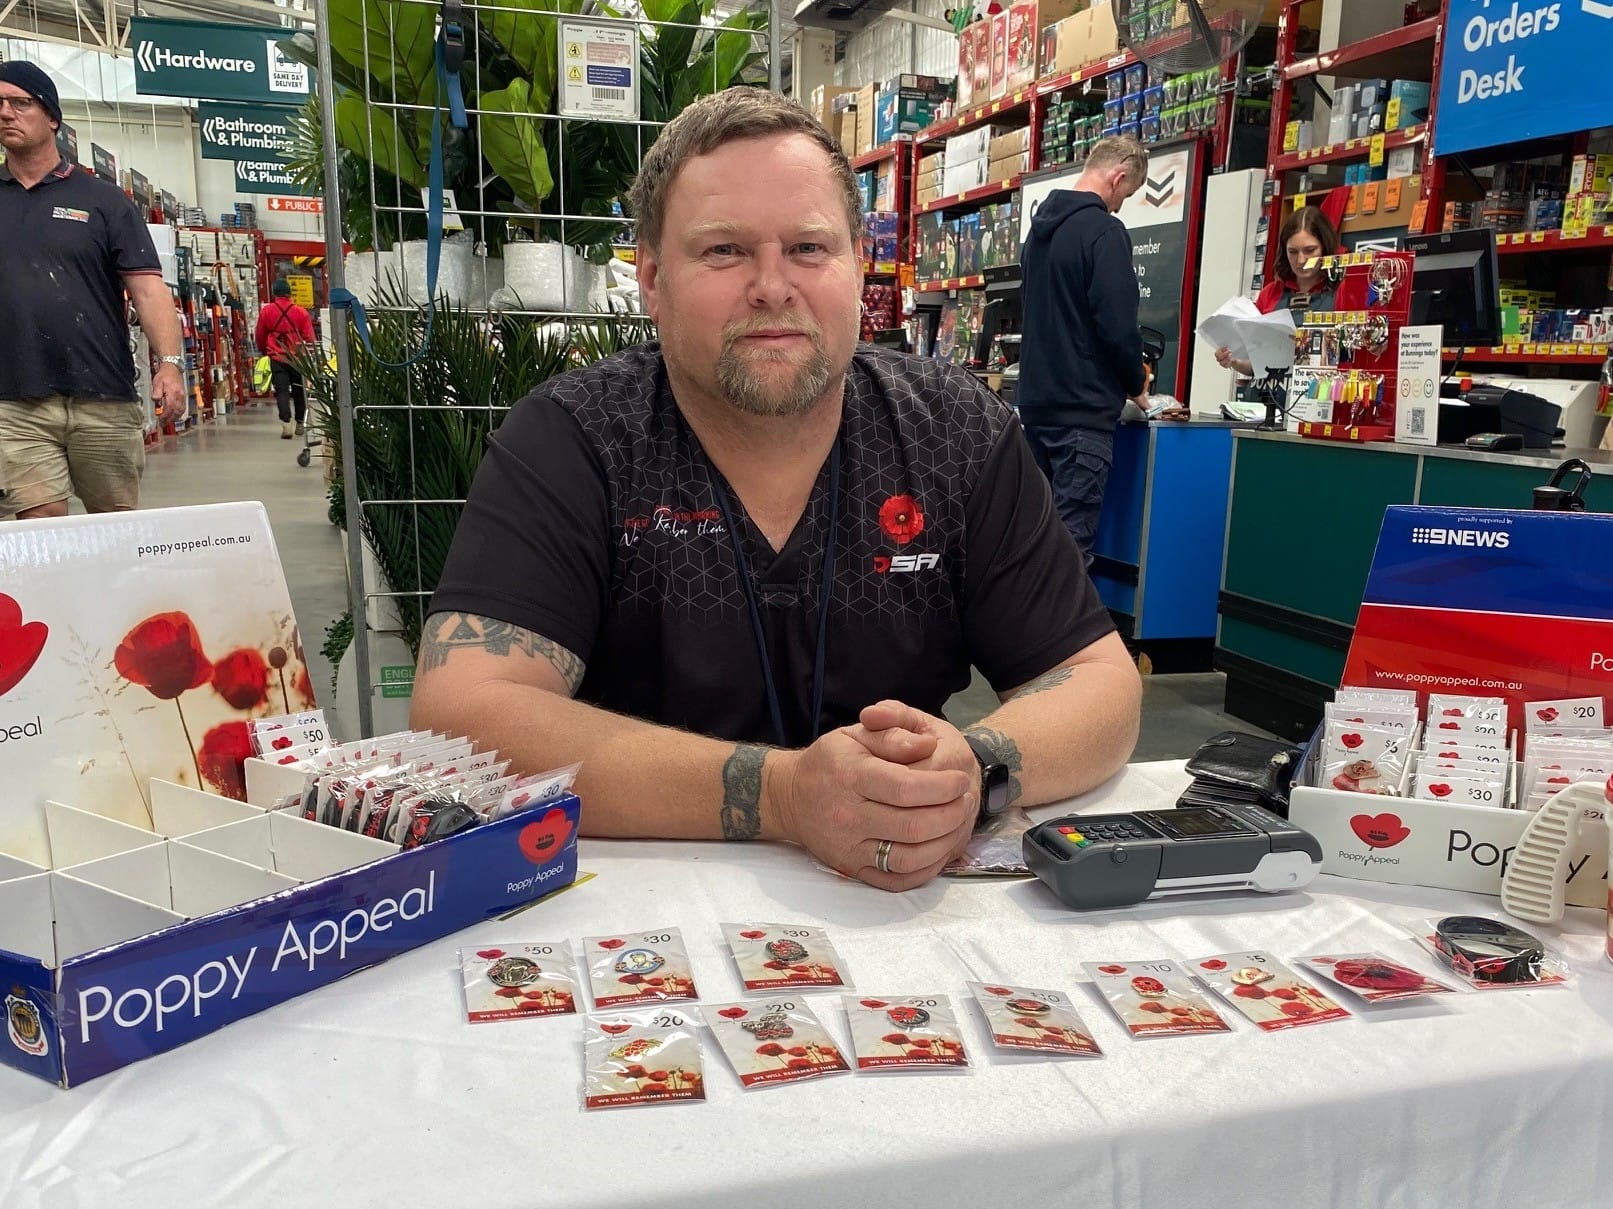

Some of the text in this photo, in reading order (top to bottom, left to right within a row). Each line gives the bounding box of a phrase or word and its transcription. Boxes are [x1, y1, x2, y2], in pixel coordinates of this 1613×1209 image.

[1463, 2, 1561, 53] Orders
[155, 48, 256, 73] Hardware
[275, 80, 303, 88] DELIVERY
[1457, 55, 1526, 104] Desk
[215, 116, 286, 135] Bathroom
[217, 132, 294, 152] & Plumbing
[248, 171, 259, 182] &
[285, 201, 316, 211] PUBLIC
[137, 534, 252, 558] poppyappeal.com.au
[1375, 669, 1523, 691] www.poppyappeal.com.au
[1573, 706, 1596, 718] $20
[303, 729, 324, 743] $50
[1385, 739, 1398, 754] $5
[542, 784, 560, 798] $30
[1468, 788, 1493, 801] $30
[1338, 850, 1400, 865] Poppy Appeal
[507, 861, 565, 894] Poppy Appeal
[643, 933, 671, 944] $30
[783, 930, 810, 938] $30
[78, 945, 259, 1044] Poppy
[271, 870, 435, 972] Appeal
[524, 946, 553, 955] $50
[1246, 954, 1267, 963] $5
[1142, 964, 1172, 973] $10
[766, 1001, 795, 1013] $20
[909, 999, 937, 1008] $20
[652, 1015, 684, 1028] $20
[783, 1067, 819, 1076] REMEMBER
